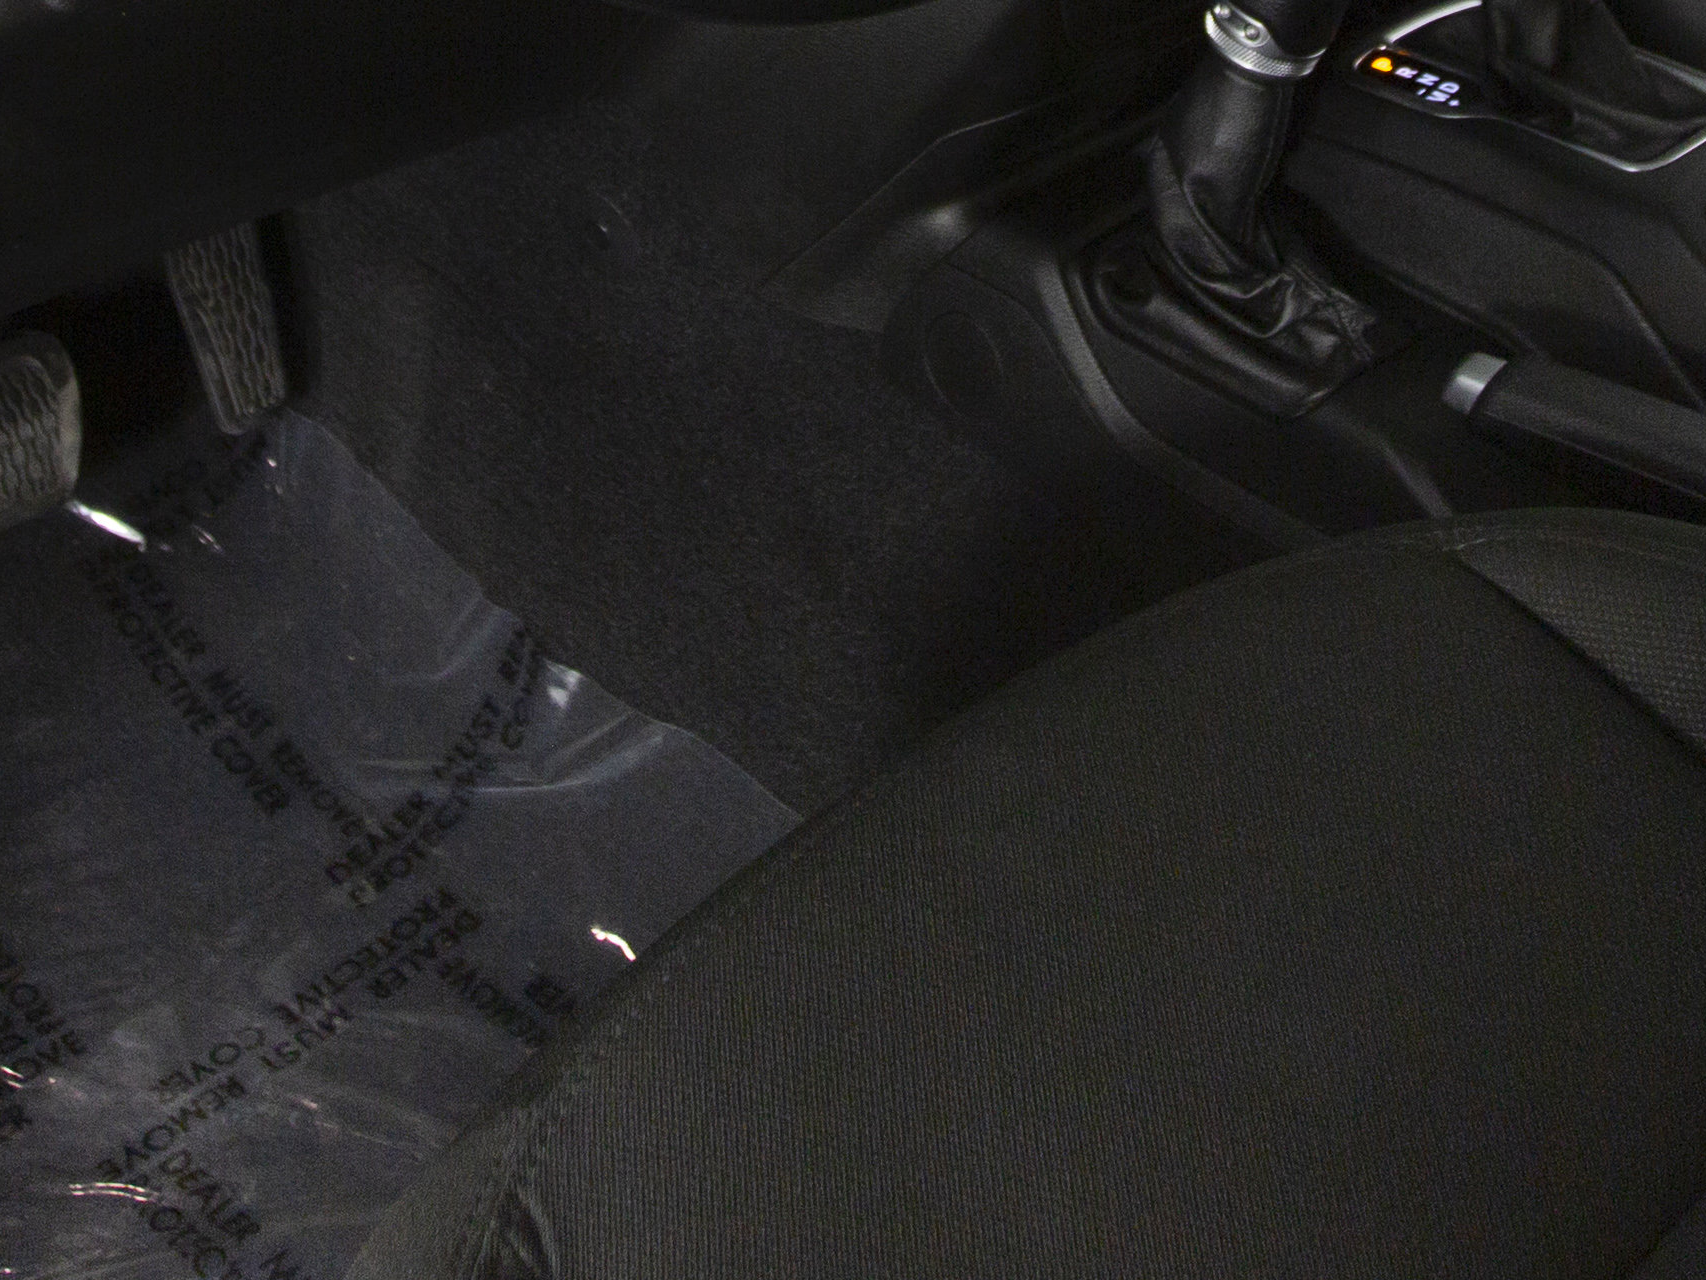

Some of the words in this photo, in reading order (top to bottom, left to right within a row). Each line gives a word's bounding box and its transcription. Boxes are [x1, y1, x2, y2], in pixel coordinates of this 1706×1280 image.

[1395, 66, 1418, 78] R
[1416, 72, 1440, 86] N
[1438, 81, 1460, 94] D
[203, 662, 275, 743] MUST
[209, 730, 293, 820] COVER
[323, 789, 432, 887] DEALER
[269, 884, 458, 1030] PROTECTIVE
[366, 904, 483, 1003] DEALER
[259, 1005, 352, 1077] MUST
[92, 1074, 248, 1187] REMOVE
[157, 1143, 262, 1250] DEALER
